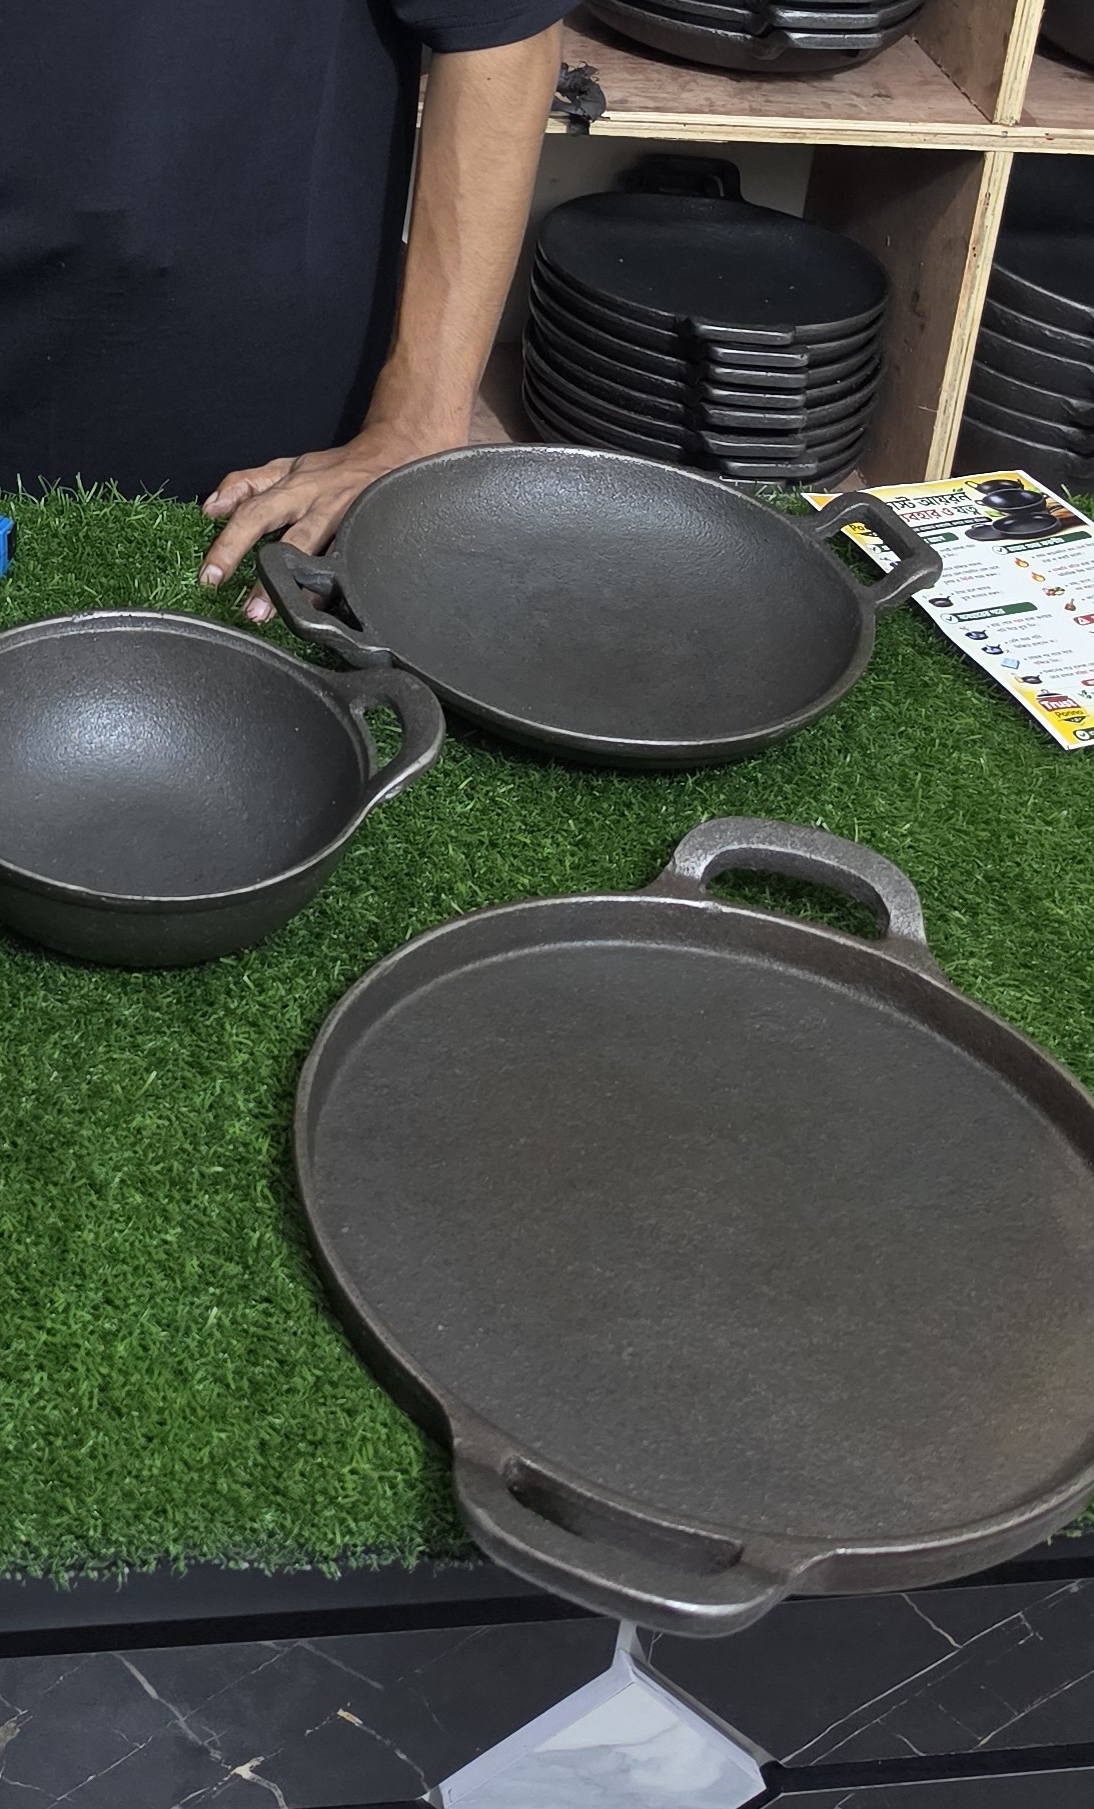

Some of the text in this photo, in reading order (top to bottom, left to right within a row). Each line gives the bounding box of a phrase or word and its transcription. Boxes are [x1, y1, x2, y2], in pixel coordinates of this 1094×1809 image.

[886, 496, 916, 510] াস্ট
[942, 507, 955, 516] ও
[1040, 698, 1078, 710] Trust
